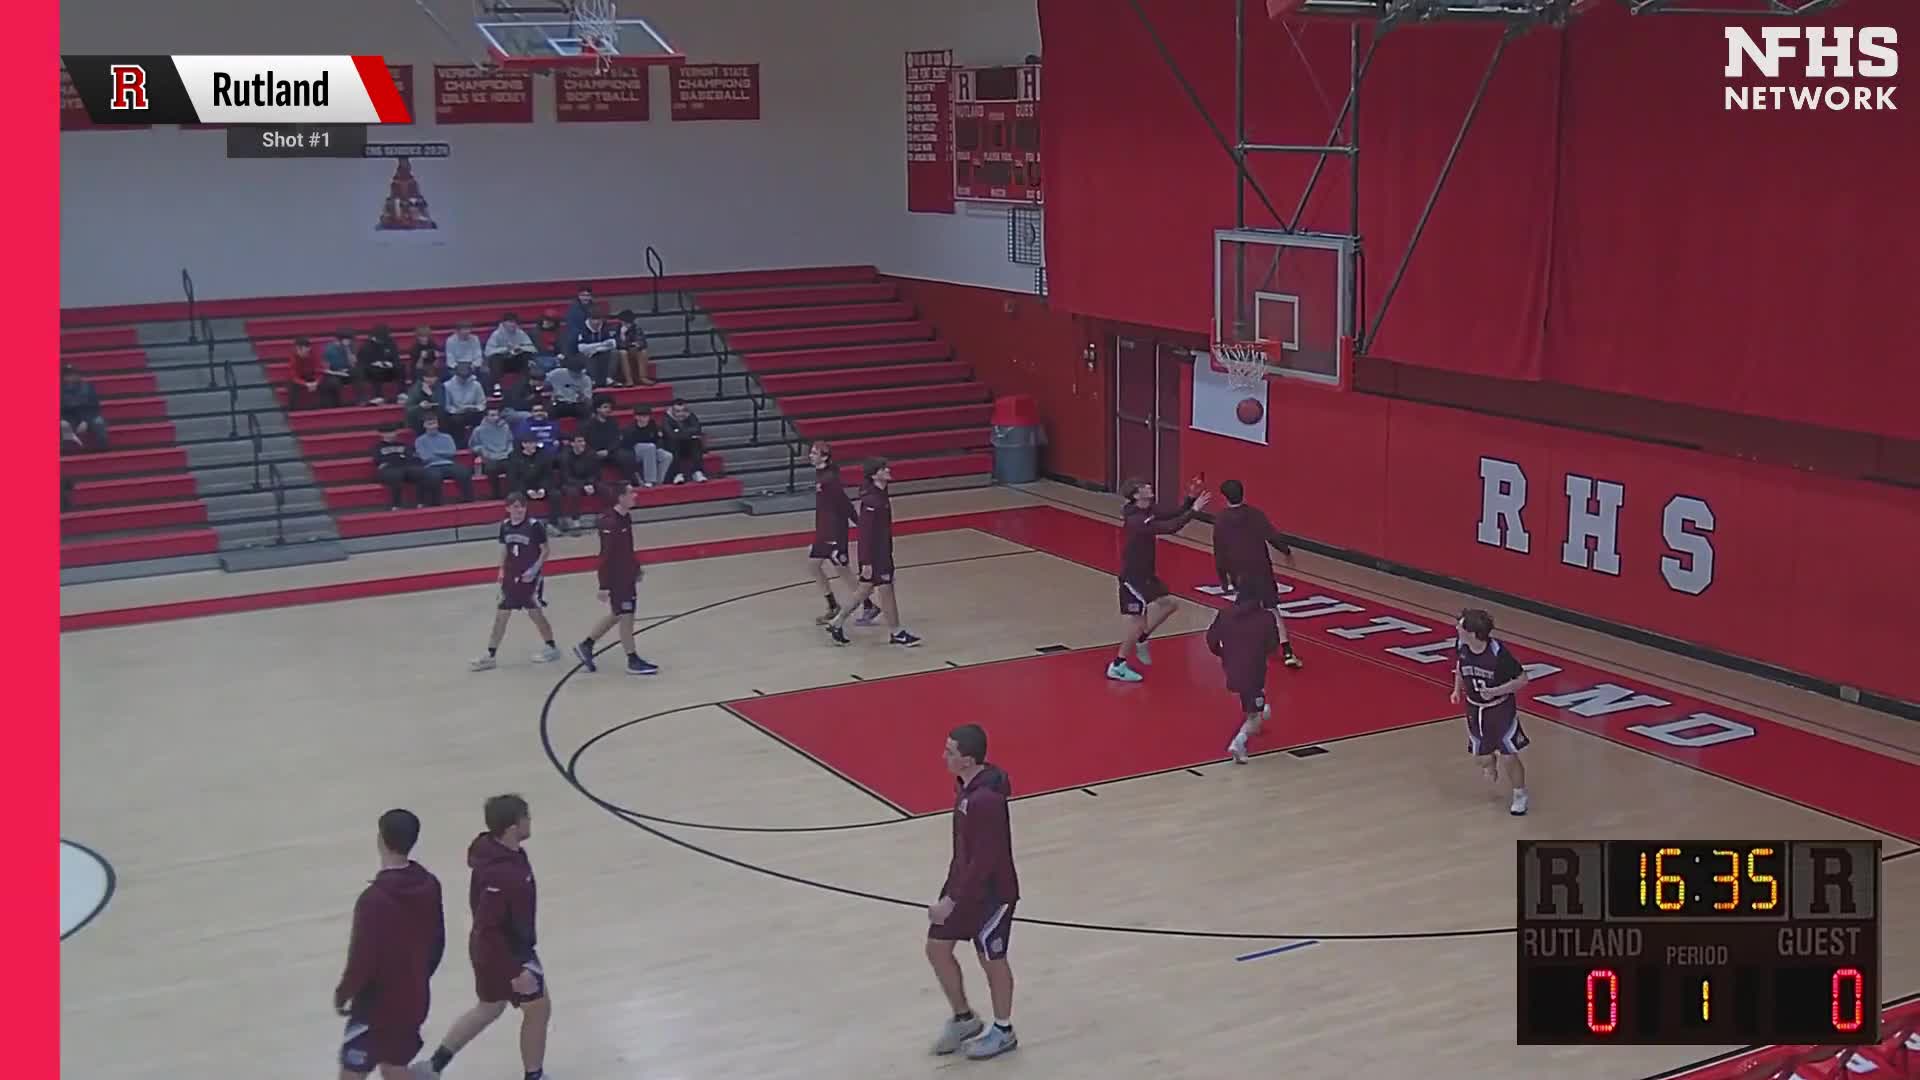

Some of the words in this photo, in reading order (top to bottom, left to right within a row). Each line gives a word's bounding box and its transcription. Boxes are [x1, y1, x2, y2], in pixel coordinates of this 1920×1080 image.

[444, 79, 524, 91] CHAMPIONS
[563, 79, 641, 89] CHAMPIONS
[678, 79, 751, 89] CHAMPIONS
[565, 90, 640, 102] SOFTBALL
[679, 90, 750, 101] BASEBALL
[1477, 457, 1716, 596] RHS
